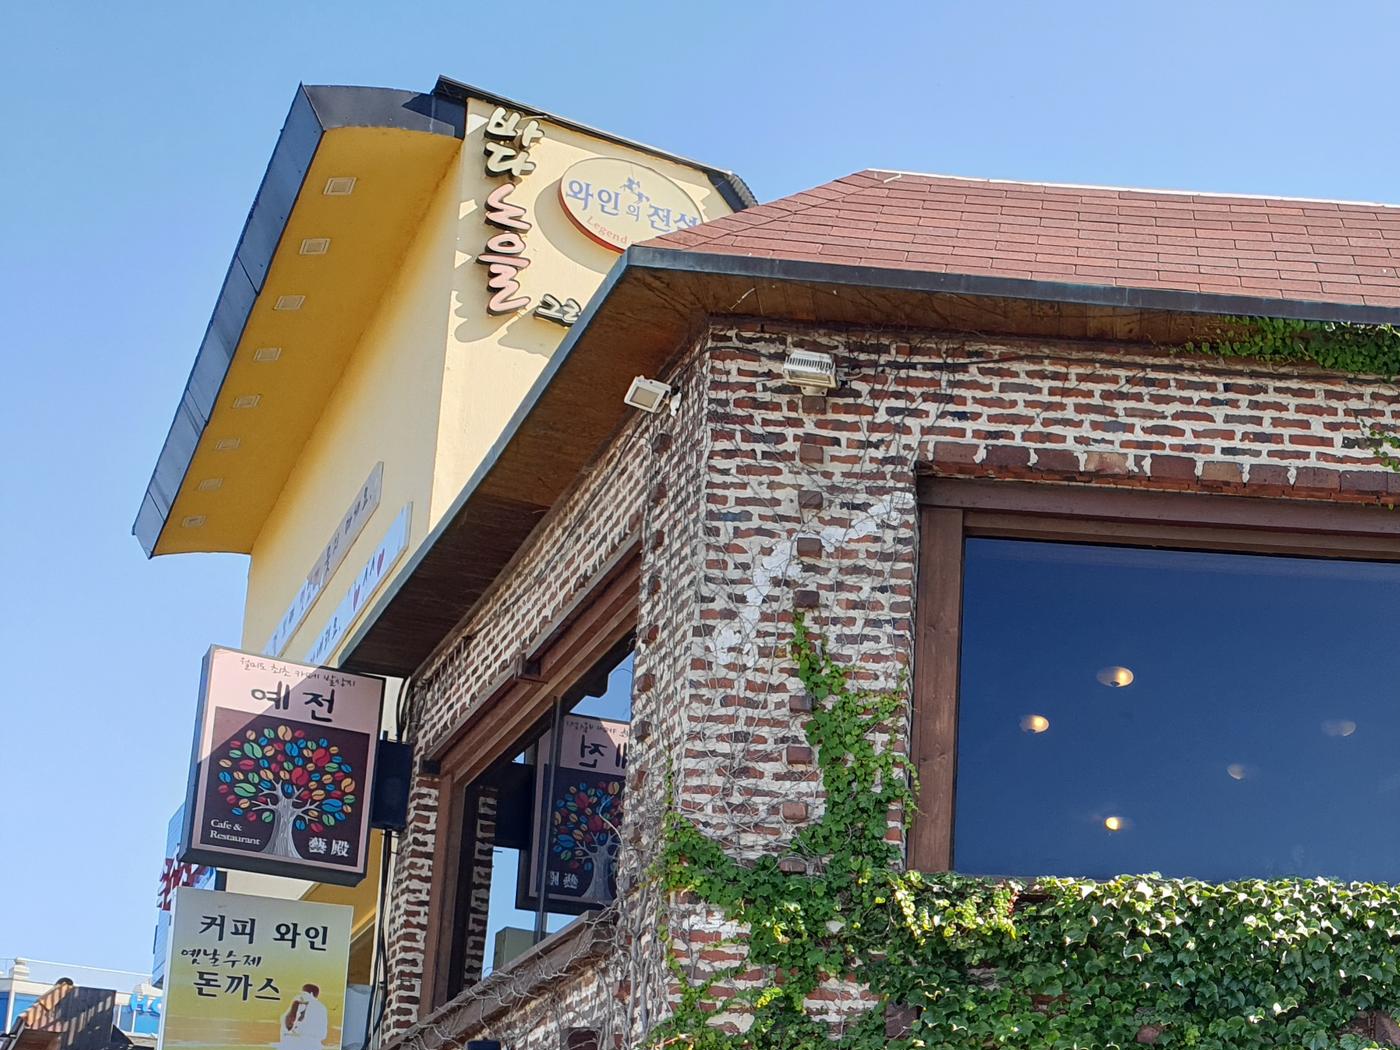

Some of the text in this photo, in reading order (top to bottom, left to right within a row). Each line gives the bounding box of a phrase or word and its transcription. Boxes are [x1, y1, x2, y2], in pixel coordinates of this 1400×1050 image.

[586, 215, 629, 244] Legend
[210, 818, 242, 832] Cafe &
[209, 830, 261, 846] Restaurant
[199, 914, 328, 951] 커피 와인
[222, 953, 262, 968] 수제
[193, 970, 281, 1001] 돈까스
